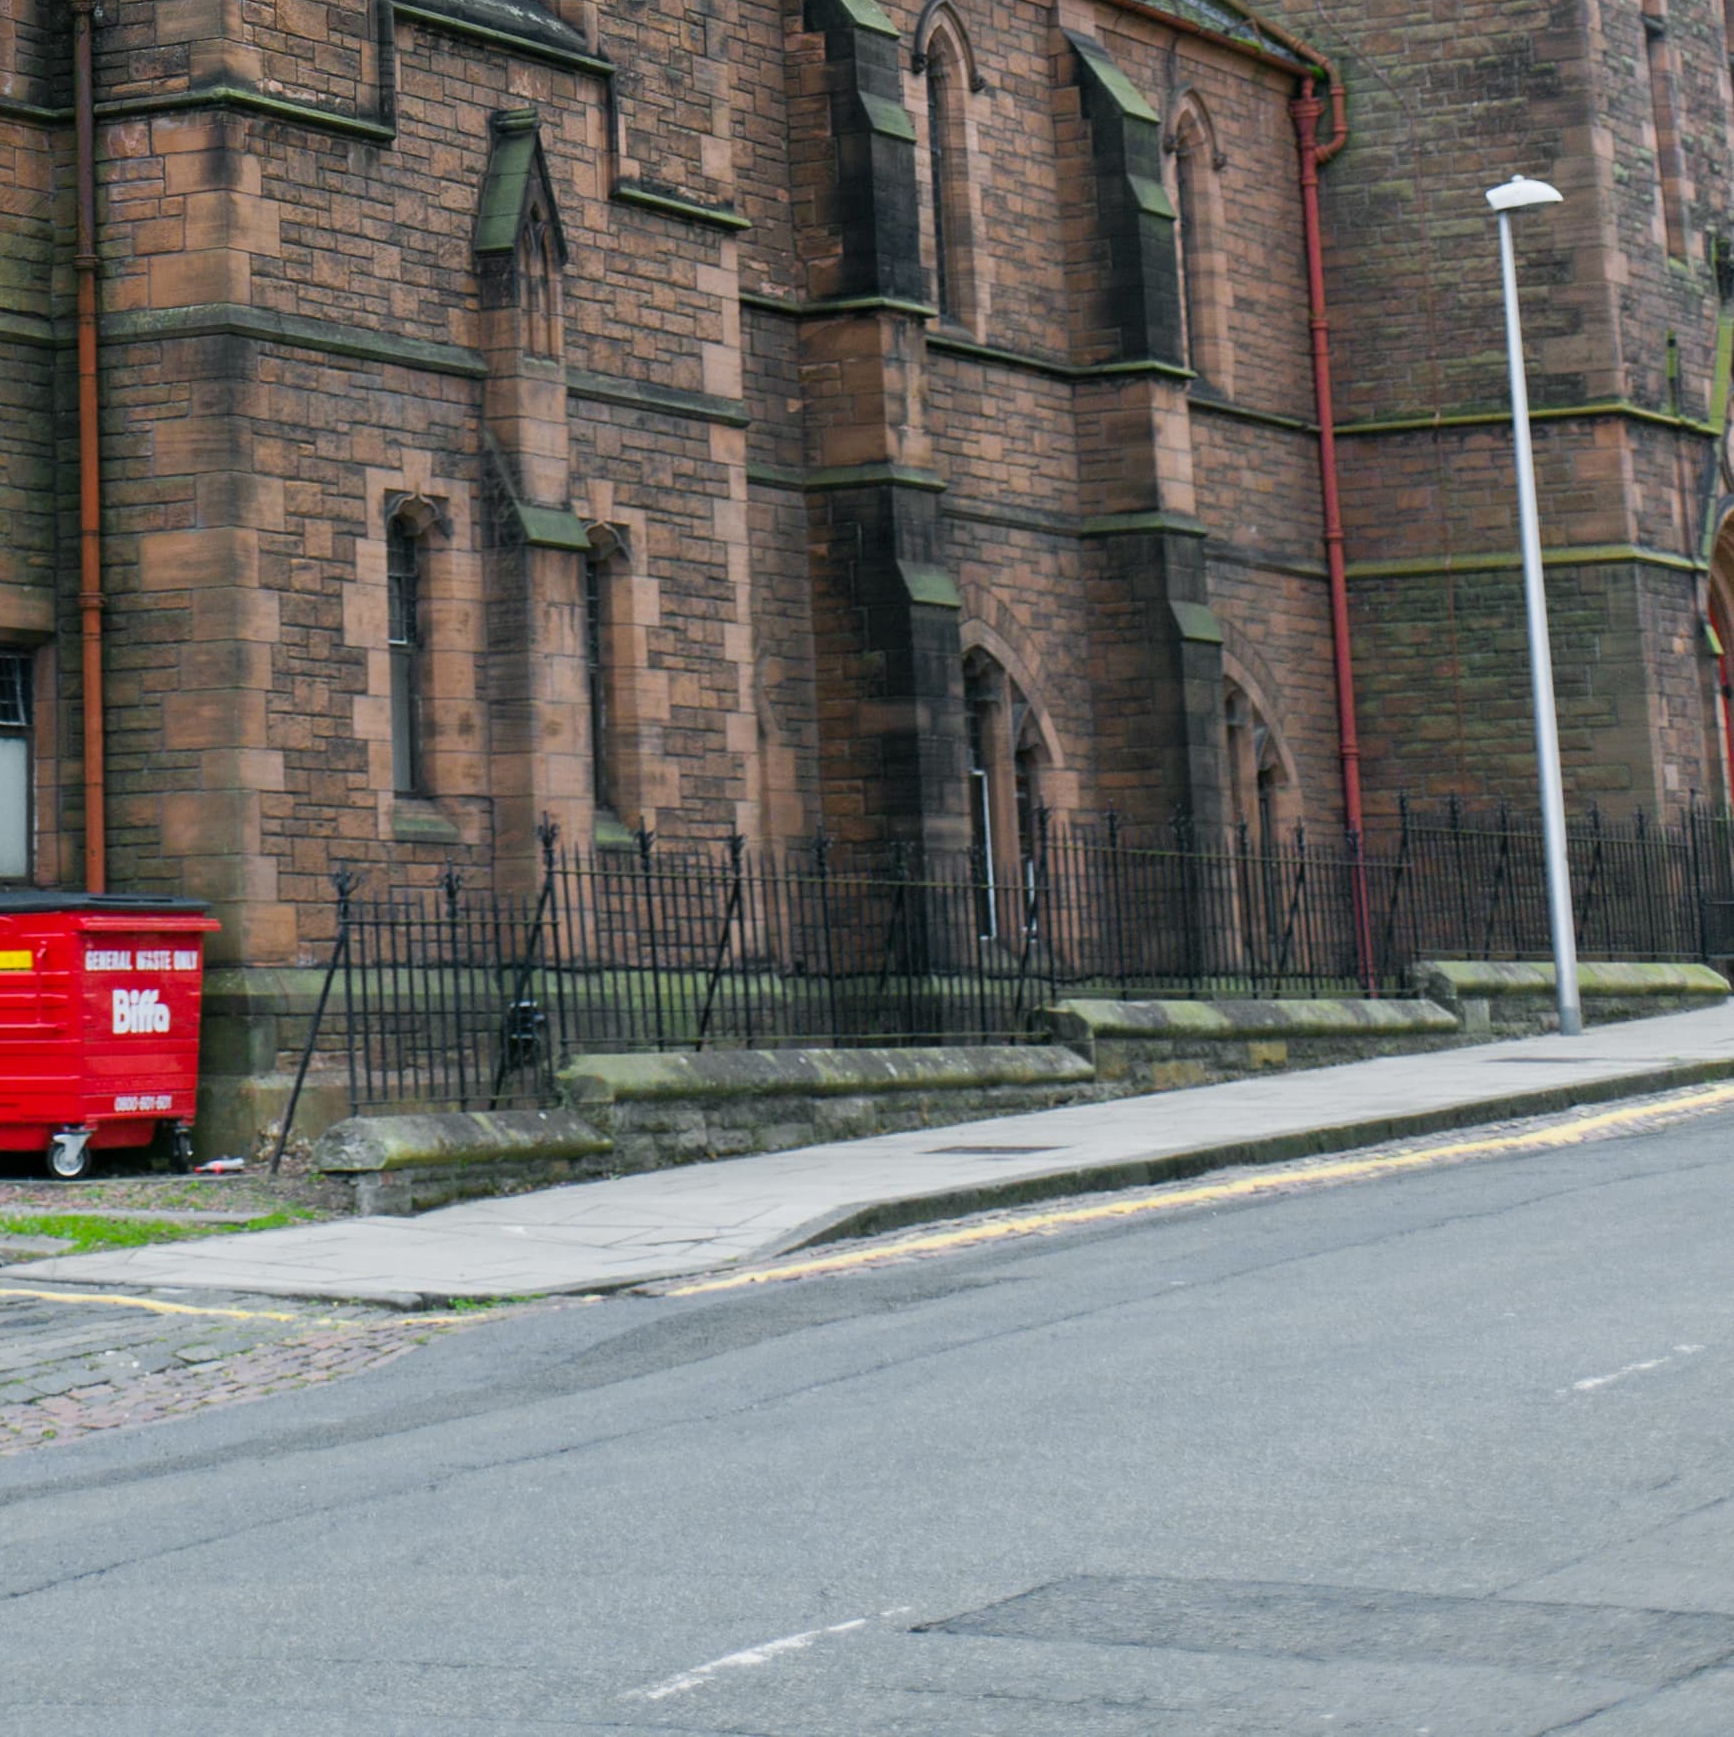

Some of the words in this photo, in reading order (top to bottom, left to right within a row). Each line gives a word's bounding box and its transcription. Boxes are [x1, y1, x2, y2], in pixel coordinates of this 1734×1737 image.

[85, 950, 133, 971] GENERAL
[136, 950, 172, 971] WASTE
[173, 950, 198, 971] ONLY
[112, 989, 170, 1034] Biffa
